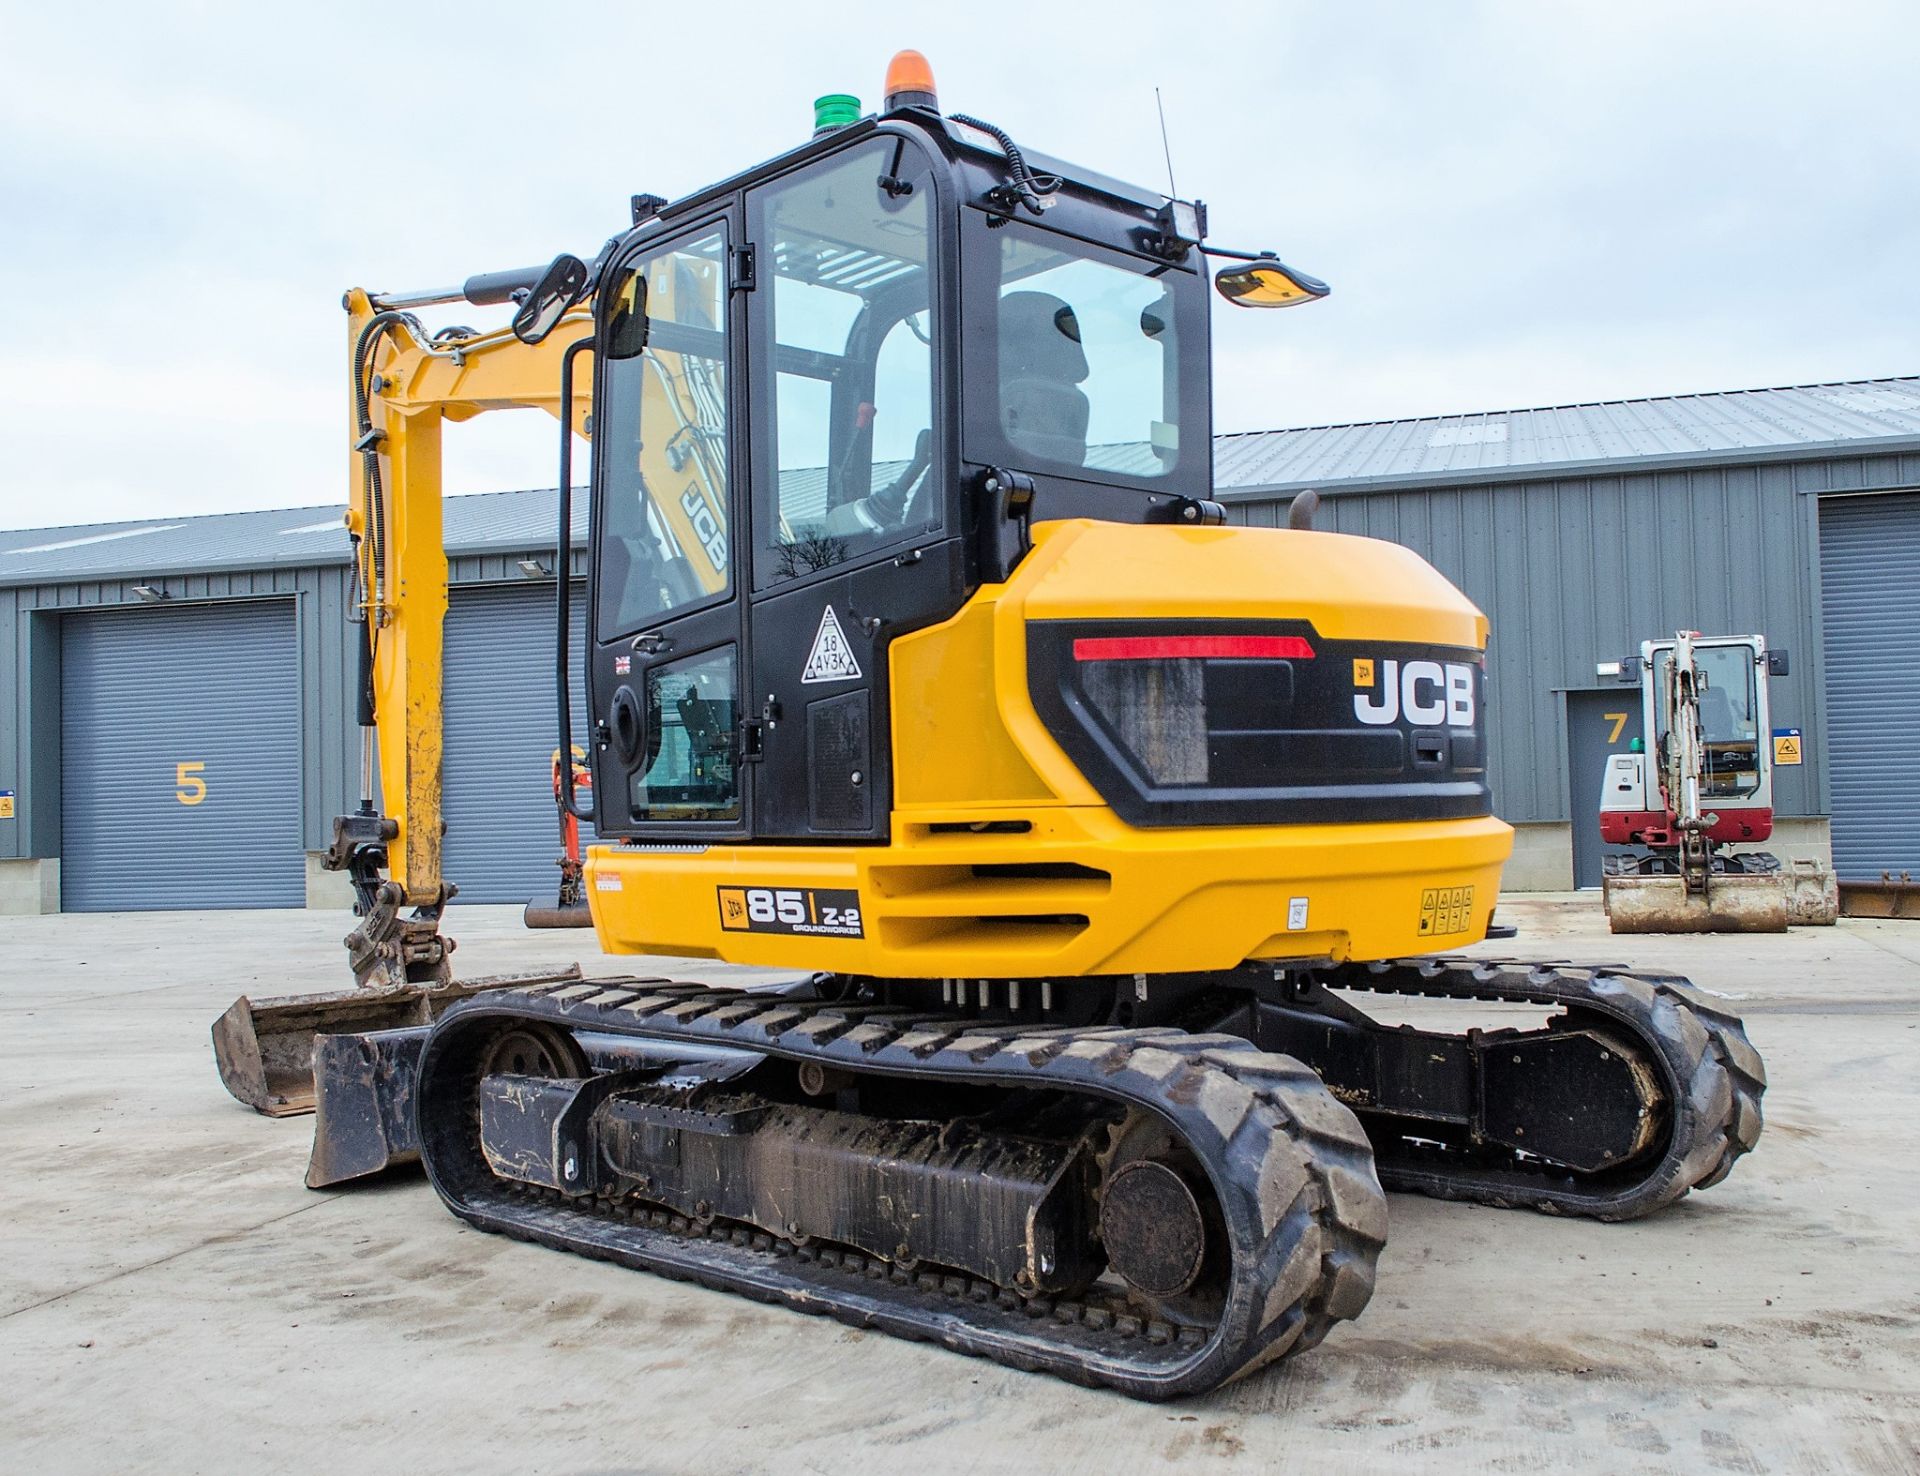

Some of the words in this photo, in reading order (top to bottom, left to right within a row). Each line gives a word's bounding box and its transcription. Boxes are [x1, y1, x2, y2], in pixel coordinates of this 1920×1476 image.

[681, 492, 727, 570] JCB
[823, 635, 837, 652] 18
[816, 653, 846, 671] AY3K
[1353, 660, 1475, 726] JCB
[1604, 713, 1628, 744] 7
[176, 762, 207, 806] 5
[747, 889, 806, 924] 85
[822, 907, 861, 927] Z-2
[793, 924, 861, 935] GROUNDWORKER
